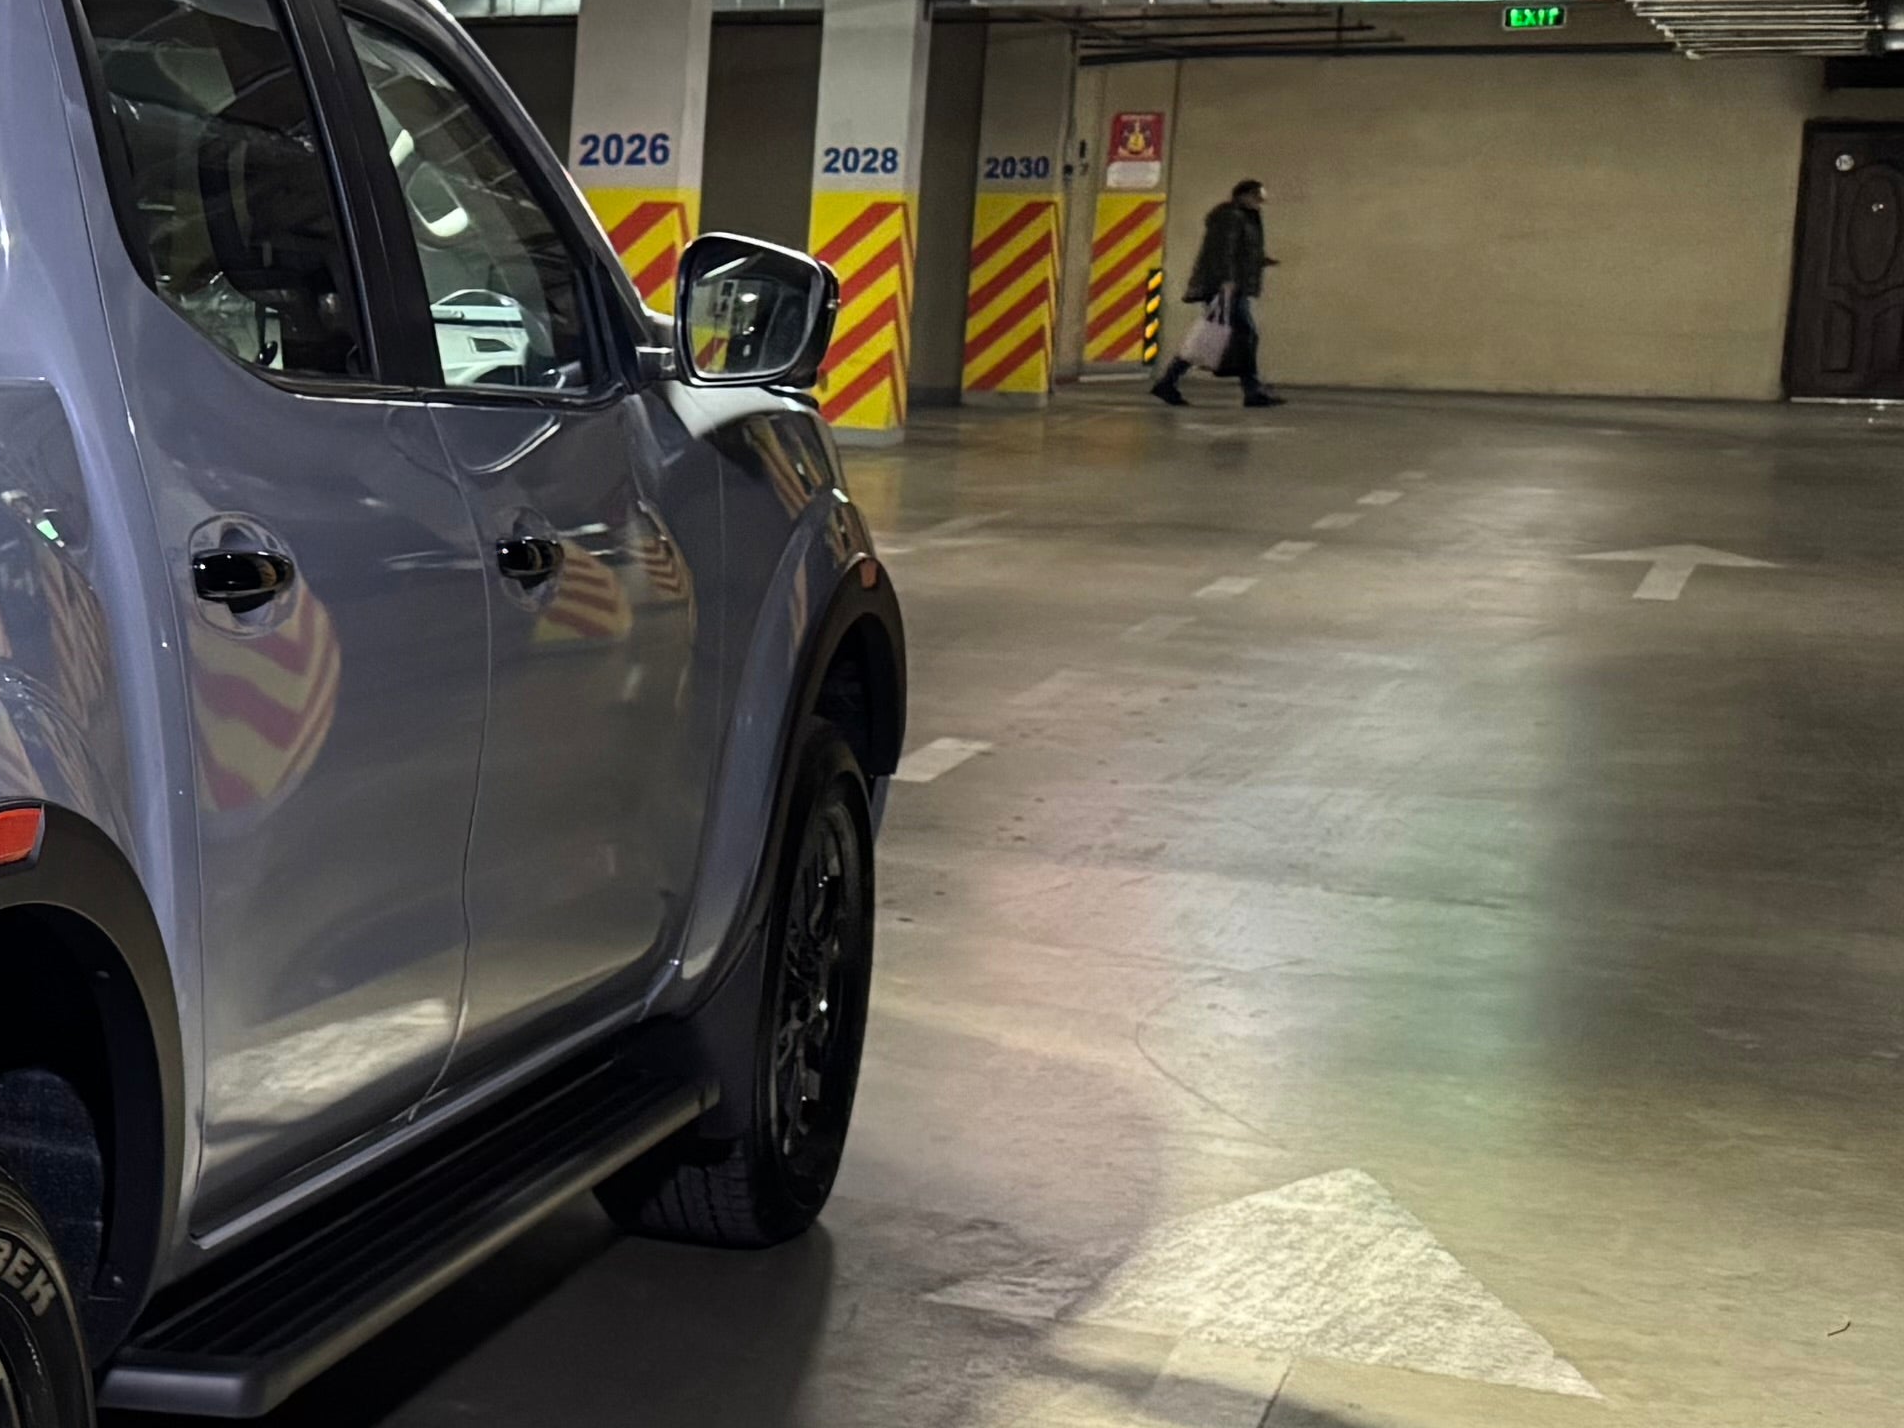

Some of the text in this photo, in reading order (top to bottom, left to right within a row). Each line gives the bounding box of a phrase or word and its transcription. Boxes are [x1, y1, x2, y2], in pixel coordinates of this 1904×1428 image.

[1510, 8, 1560, 26] EXIT
[579, 133, 670, 166] 2026
[823, 147, 898, 174] 2028
[985, 156, 1050, 179] 2030
